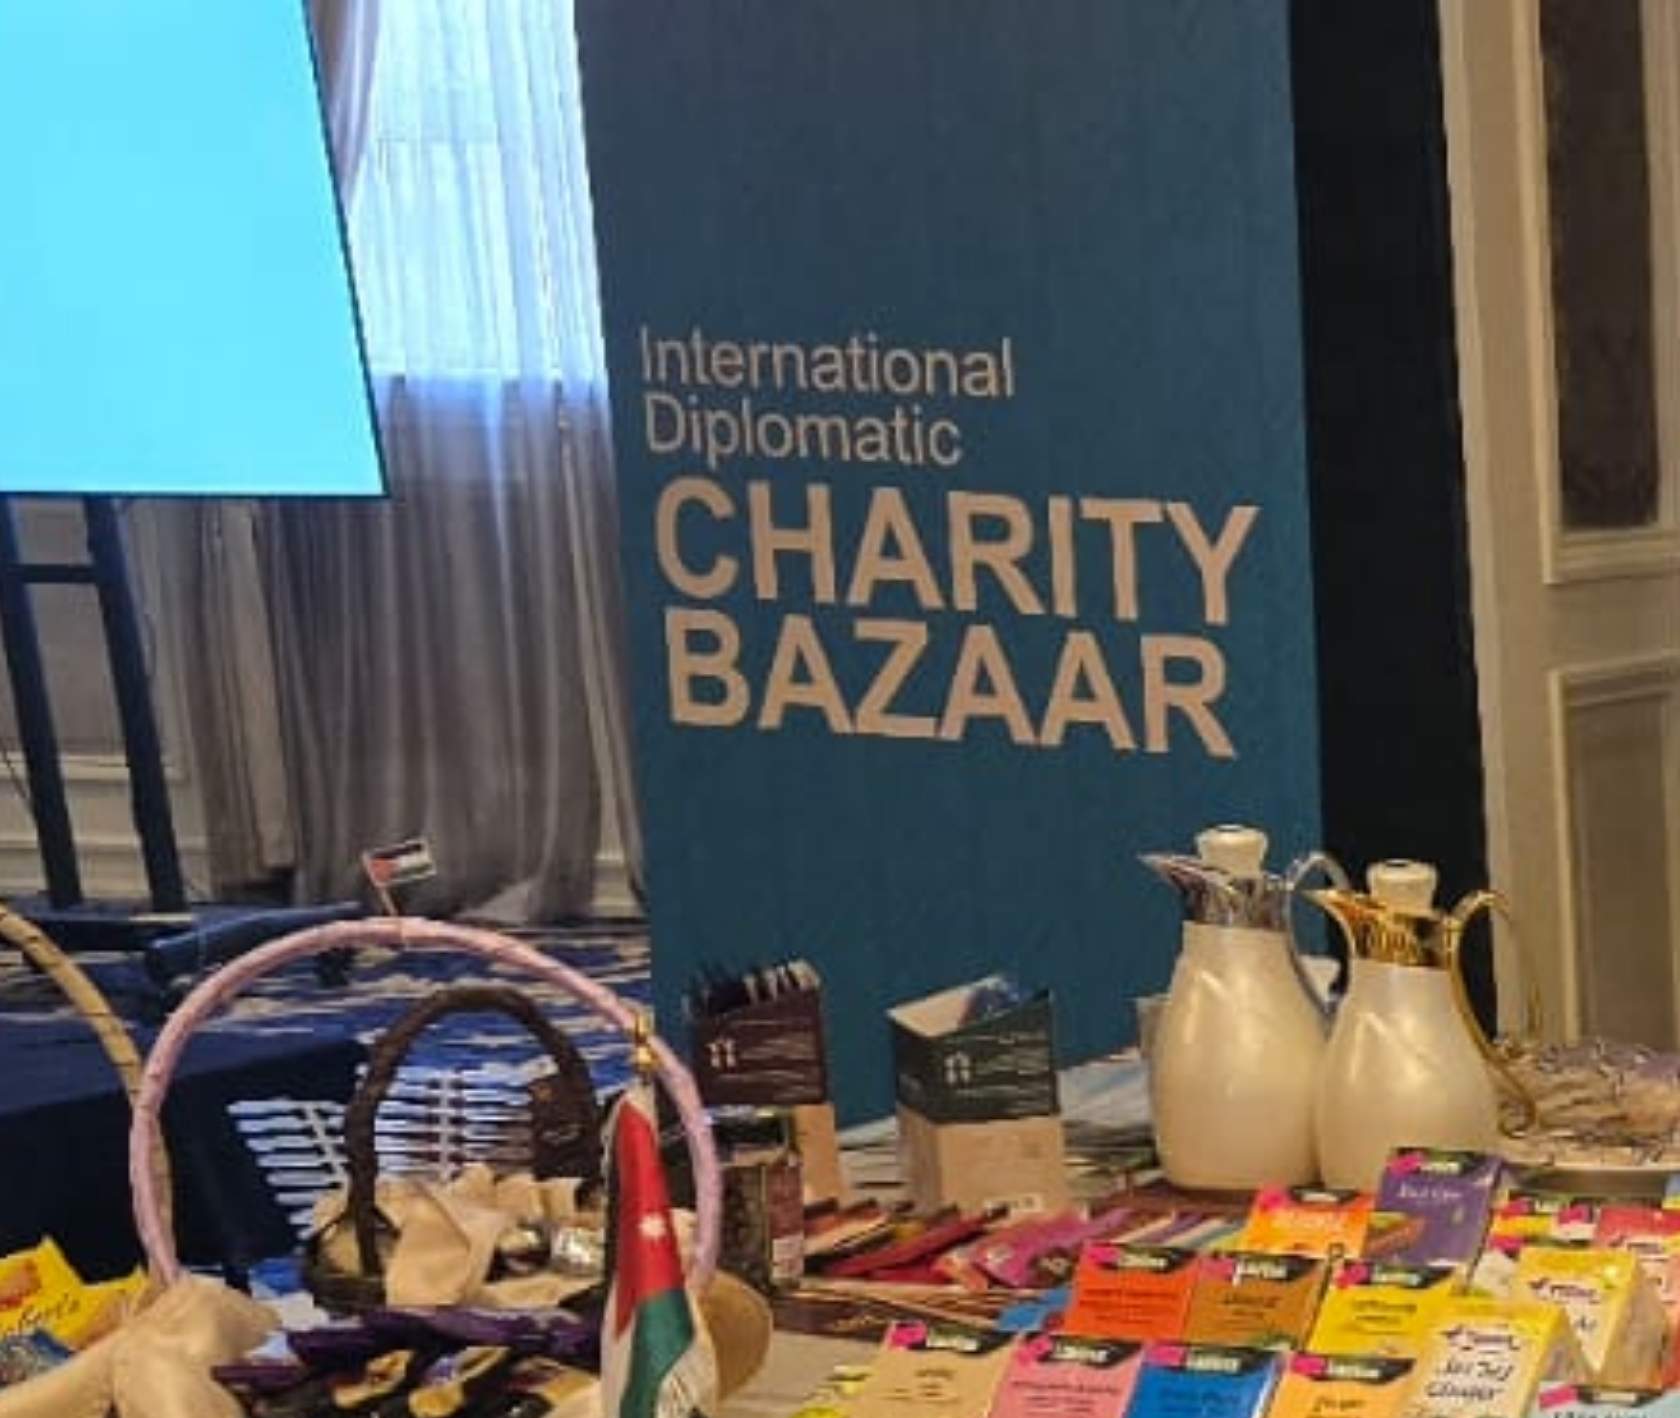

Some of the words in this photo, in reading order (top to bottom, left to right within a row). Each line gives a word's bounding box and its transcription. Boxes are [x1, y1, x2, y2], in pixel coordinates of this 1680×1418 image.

[641, 325, 1015, 398] International
[644, 392, 963, 468] Diplomatic
[655, 476, 1260, 626] CHARITY
[664, 605, 1237, 760] BAZAAR
